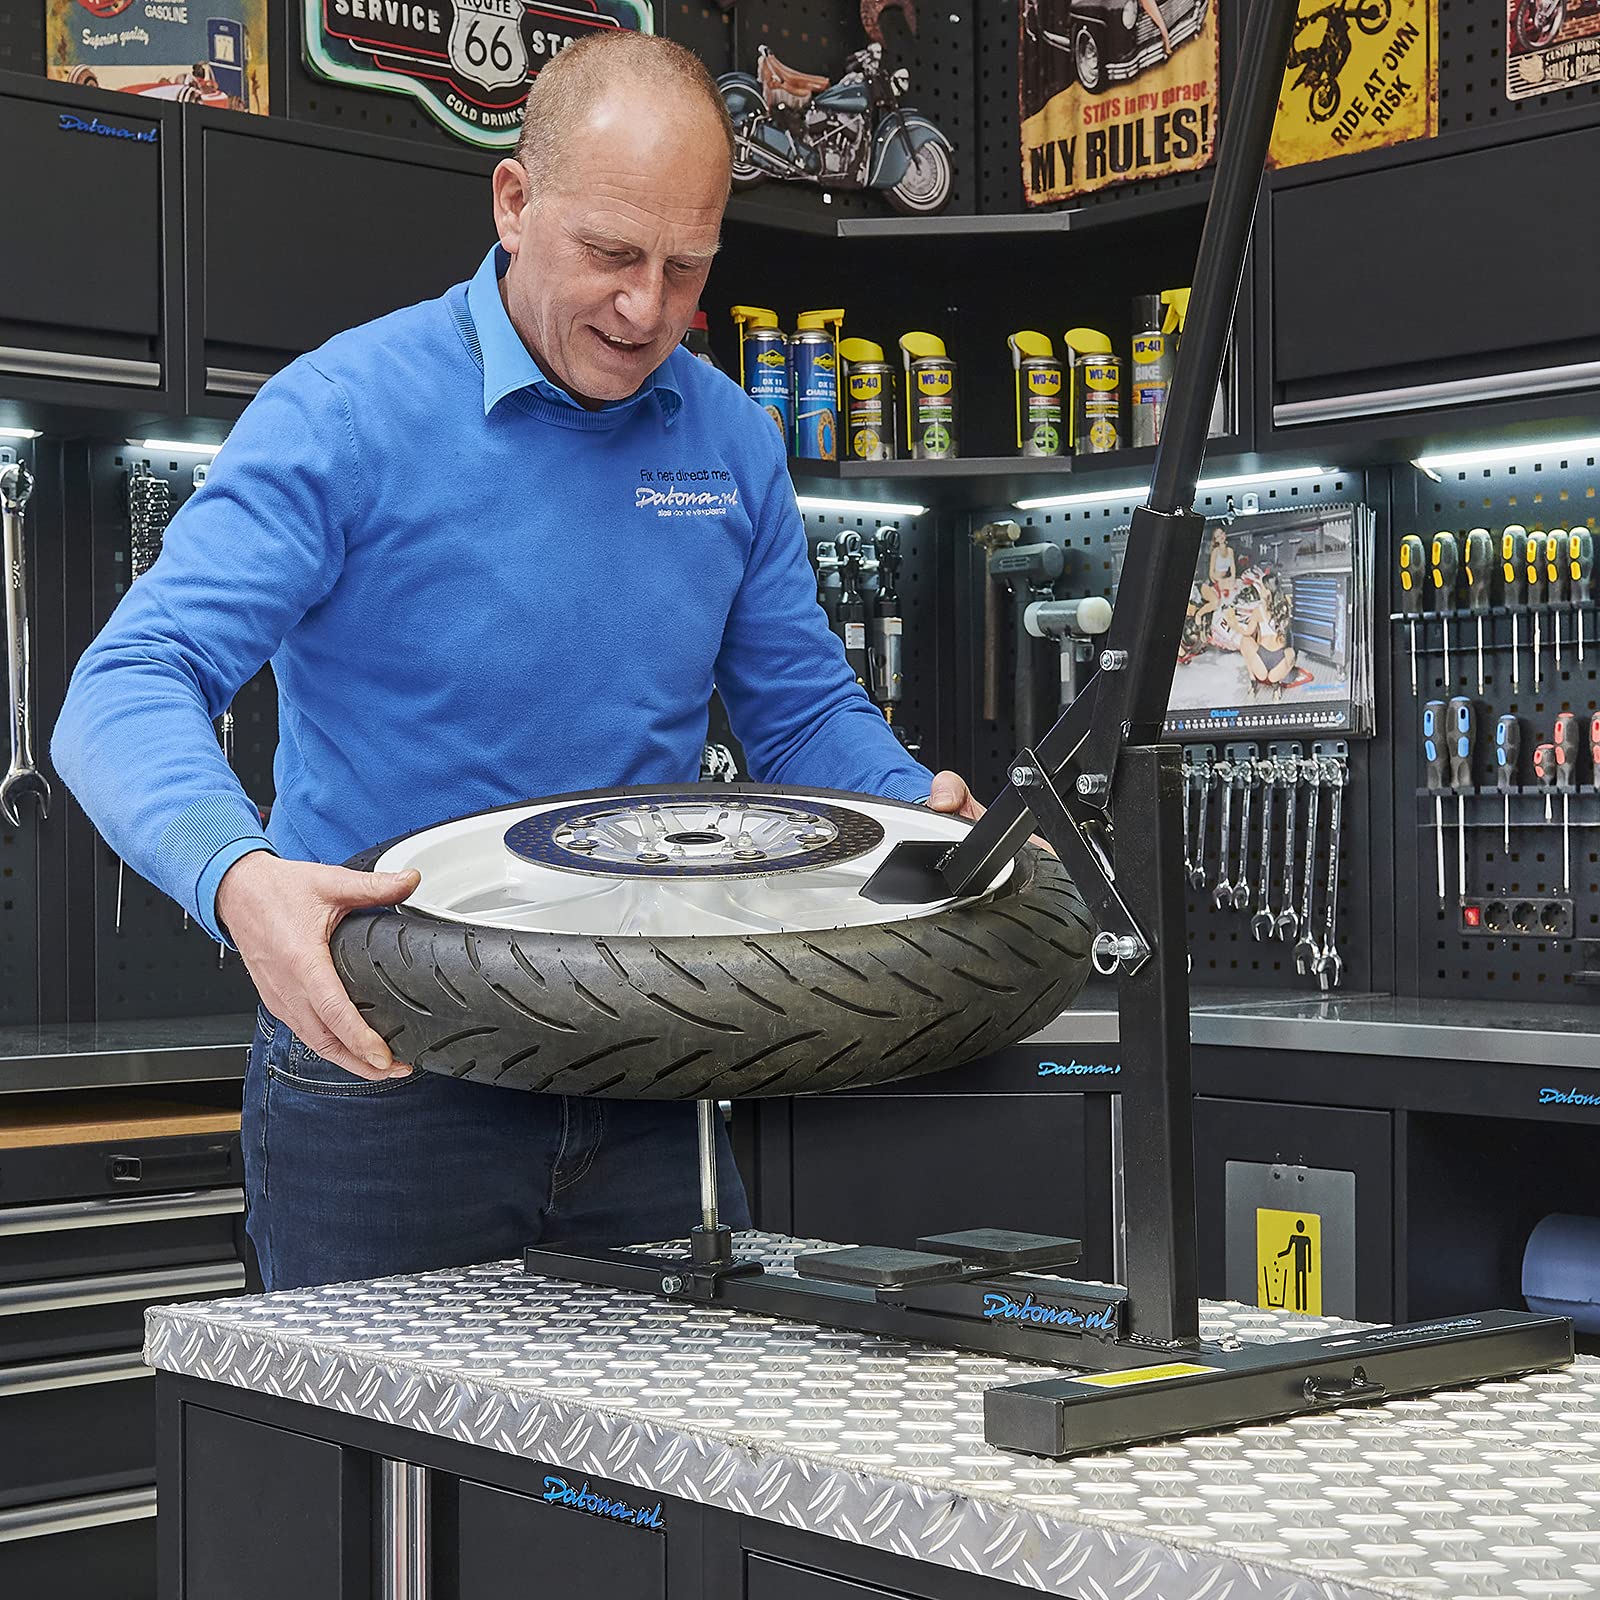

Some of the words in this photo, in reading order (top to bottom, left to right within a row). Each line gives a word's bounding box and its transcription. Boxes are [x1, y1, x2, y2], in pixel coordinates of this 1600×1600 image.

[144, 5, 188, 24] GASOLINE
[335, 0, 441, 34] SERVICE
[120, 26, 150, 47] quality
[465, 20, 512, 71] 66
[1331, 96, 1369, 147] RIDE
[1364, 68, 1386, 102] AT
[1382, 21, 1420, 71] OWN
[446, 93, 478, 121] COLD
[481, 107, 524, 126] DRINKS
[1083, 98, 1120, 125] STAYS
[1124, 96, 1136, 115] in
[1138, 92, 1158, 111] my
[1371, 74, 1411, 127] RISK
[59, 114, 158, 142] Datona.nl
[1030, 135, 1077, 194] MY
[1086, 104, 1209, 180] RULES!
[852, 377, 877, 389] WD-40
[922, 374, 949, 385] WD-40
[1033, 373, 1058, 385] WD-40
[1089, 368, 1116, 380] WD-40
[640, 468, 653, 481] Fix
[656, 468, 674, 481] het
[676, 468, 709, 481] direct
[635, 485, 738, 508] Datona.nl
[983, 1292, 1116, 1330] Datona.nl
[543, 1475, 664, 1528] Datona.nl
